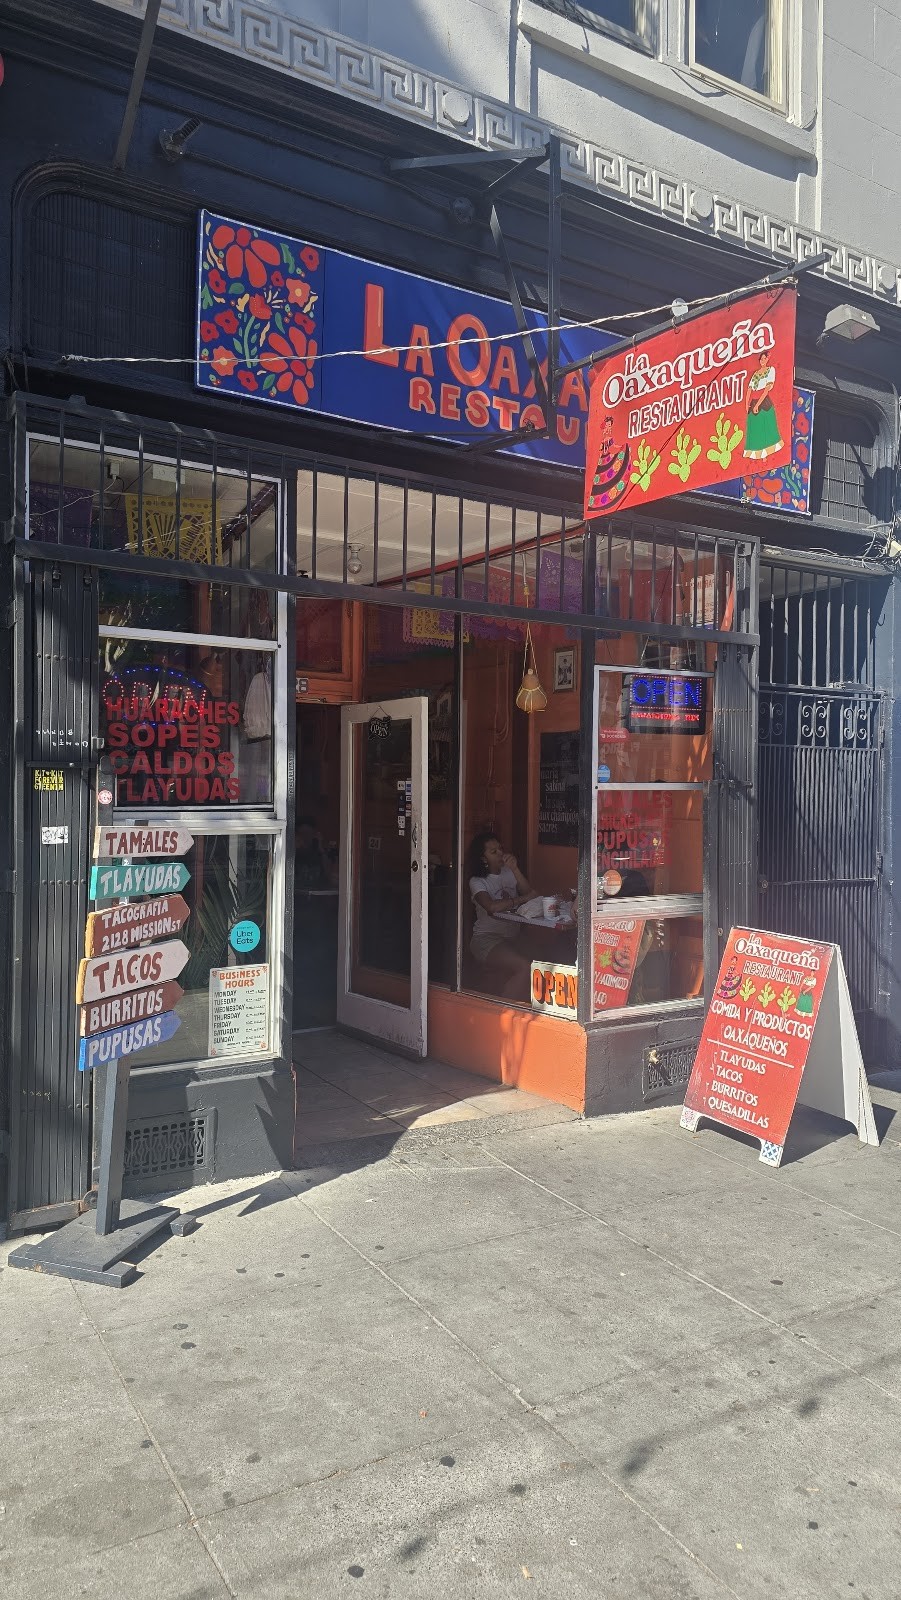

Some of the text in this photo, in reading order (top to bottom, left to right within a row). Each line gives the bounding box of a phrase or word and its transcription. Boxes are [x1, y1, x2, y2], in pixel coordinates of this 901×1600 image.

[446, 313, 589, 413] OAXA
[602, 319, 775, 409] Oaxaqueña
[625, 353, 650, 375] La
[628, 370, 747, 439] RESTAURANT
[632, 679, 699, 706] OPEN
[106, 697, 240, 727] HUARACHES
[107, 723, 221, 748] SOPES
[110, 751, 236, 775] CALDOS
[116, 777, 241, 802] TLAYUDAS
[106, 831, 178, 855] TAMALES
[100, 865, 181, 895] TLAYUDAS
[102, 900, 169, 929] TACOGRAFIA
[102, 917, 181, 952] 2128 MISSION ST
[236, 930, 254, 938] Uber
[749, 933, 762, 946] La
[735, 938, 820, 970] Oaxaqueña
[93, 952, 163, 993] TACOS
[225, 979, 255, 989] HOURS
[743, 960, 804, 986] RESTAURANT
[214, 990, 237, 999] MONDAY
[214, 997, 237, 1006] TUESDAY
[533, 968, 578, 1009] OPEN
[89, 988, 164, 1031] BURRITOS
[213, 1004, 245, 1014] WEDNESDAY
[213, 1012, 241, 1021] THURSDAY
[710, 1000, 812, 1041] COMIDA Y PRODUCTOS
[213, 1020, 232, 1029] FRIDAY
[213, 1028, 240, 1037] SATURDAY
[88, 1017, 162, 1067] PUPUSAS
[213, 1035, 235, 1044] SUNDAY
[723, 1024, 789, 1058] OAXAQUEÑOS
[716, 1065, 744, 1084] TACOS
[720, 1049, 767, 1075] TLAYUDAS
[711, 1080, 759, 1107] BURRITOS
[708, 1096, 770, 1129] QUESADILLAS
